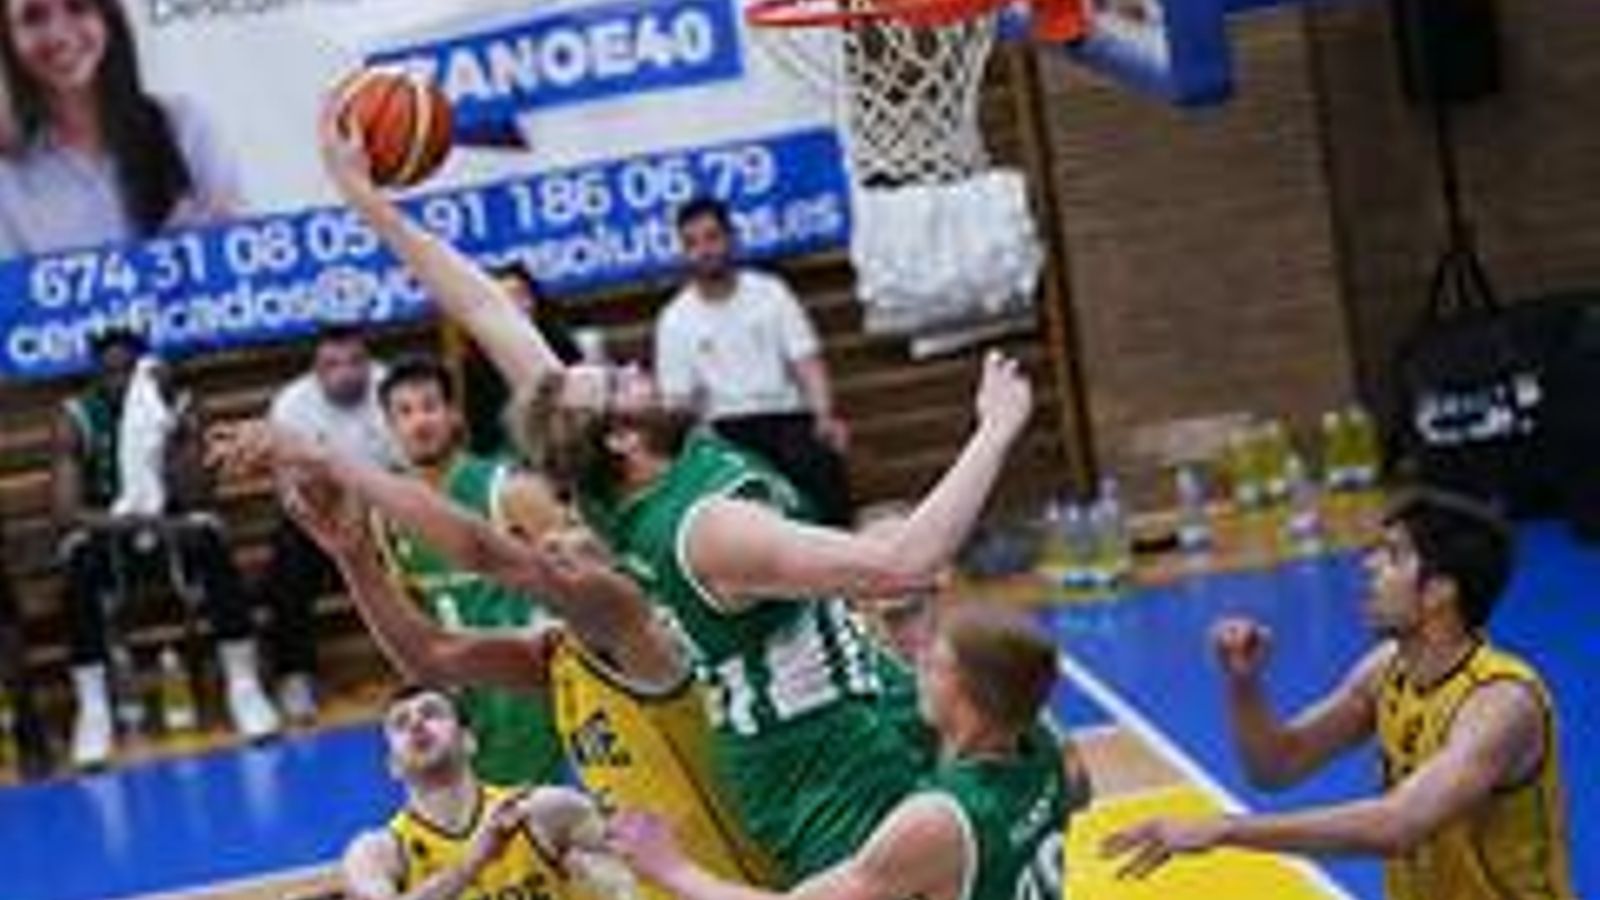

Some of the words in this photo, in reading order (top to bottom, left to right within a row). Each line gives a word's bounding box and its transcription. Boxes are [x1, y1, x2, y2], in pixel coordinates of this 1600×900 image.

[31, 251, 137, 308] 674
[149, 233, 206, 288] 31
[224, 218, 298, 275] 08
[306, 206, 378, 262] 05
[423, 191, 487, 241] 91
[510, 171, 612, 229] 186
[620, 158, 693, 209] 06
[701, 145, 776, 200] 79
